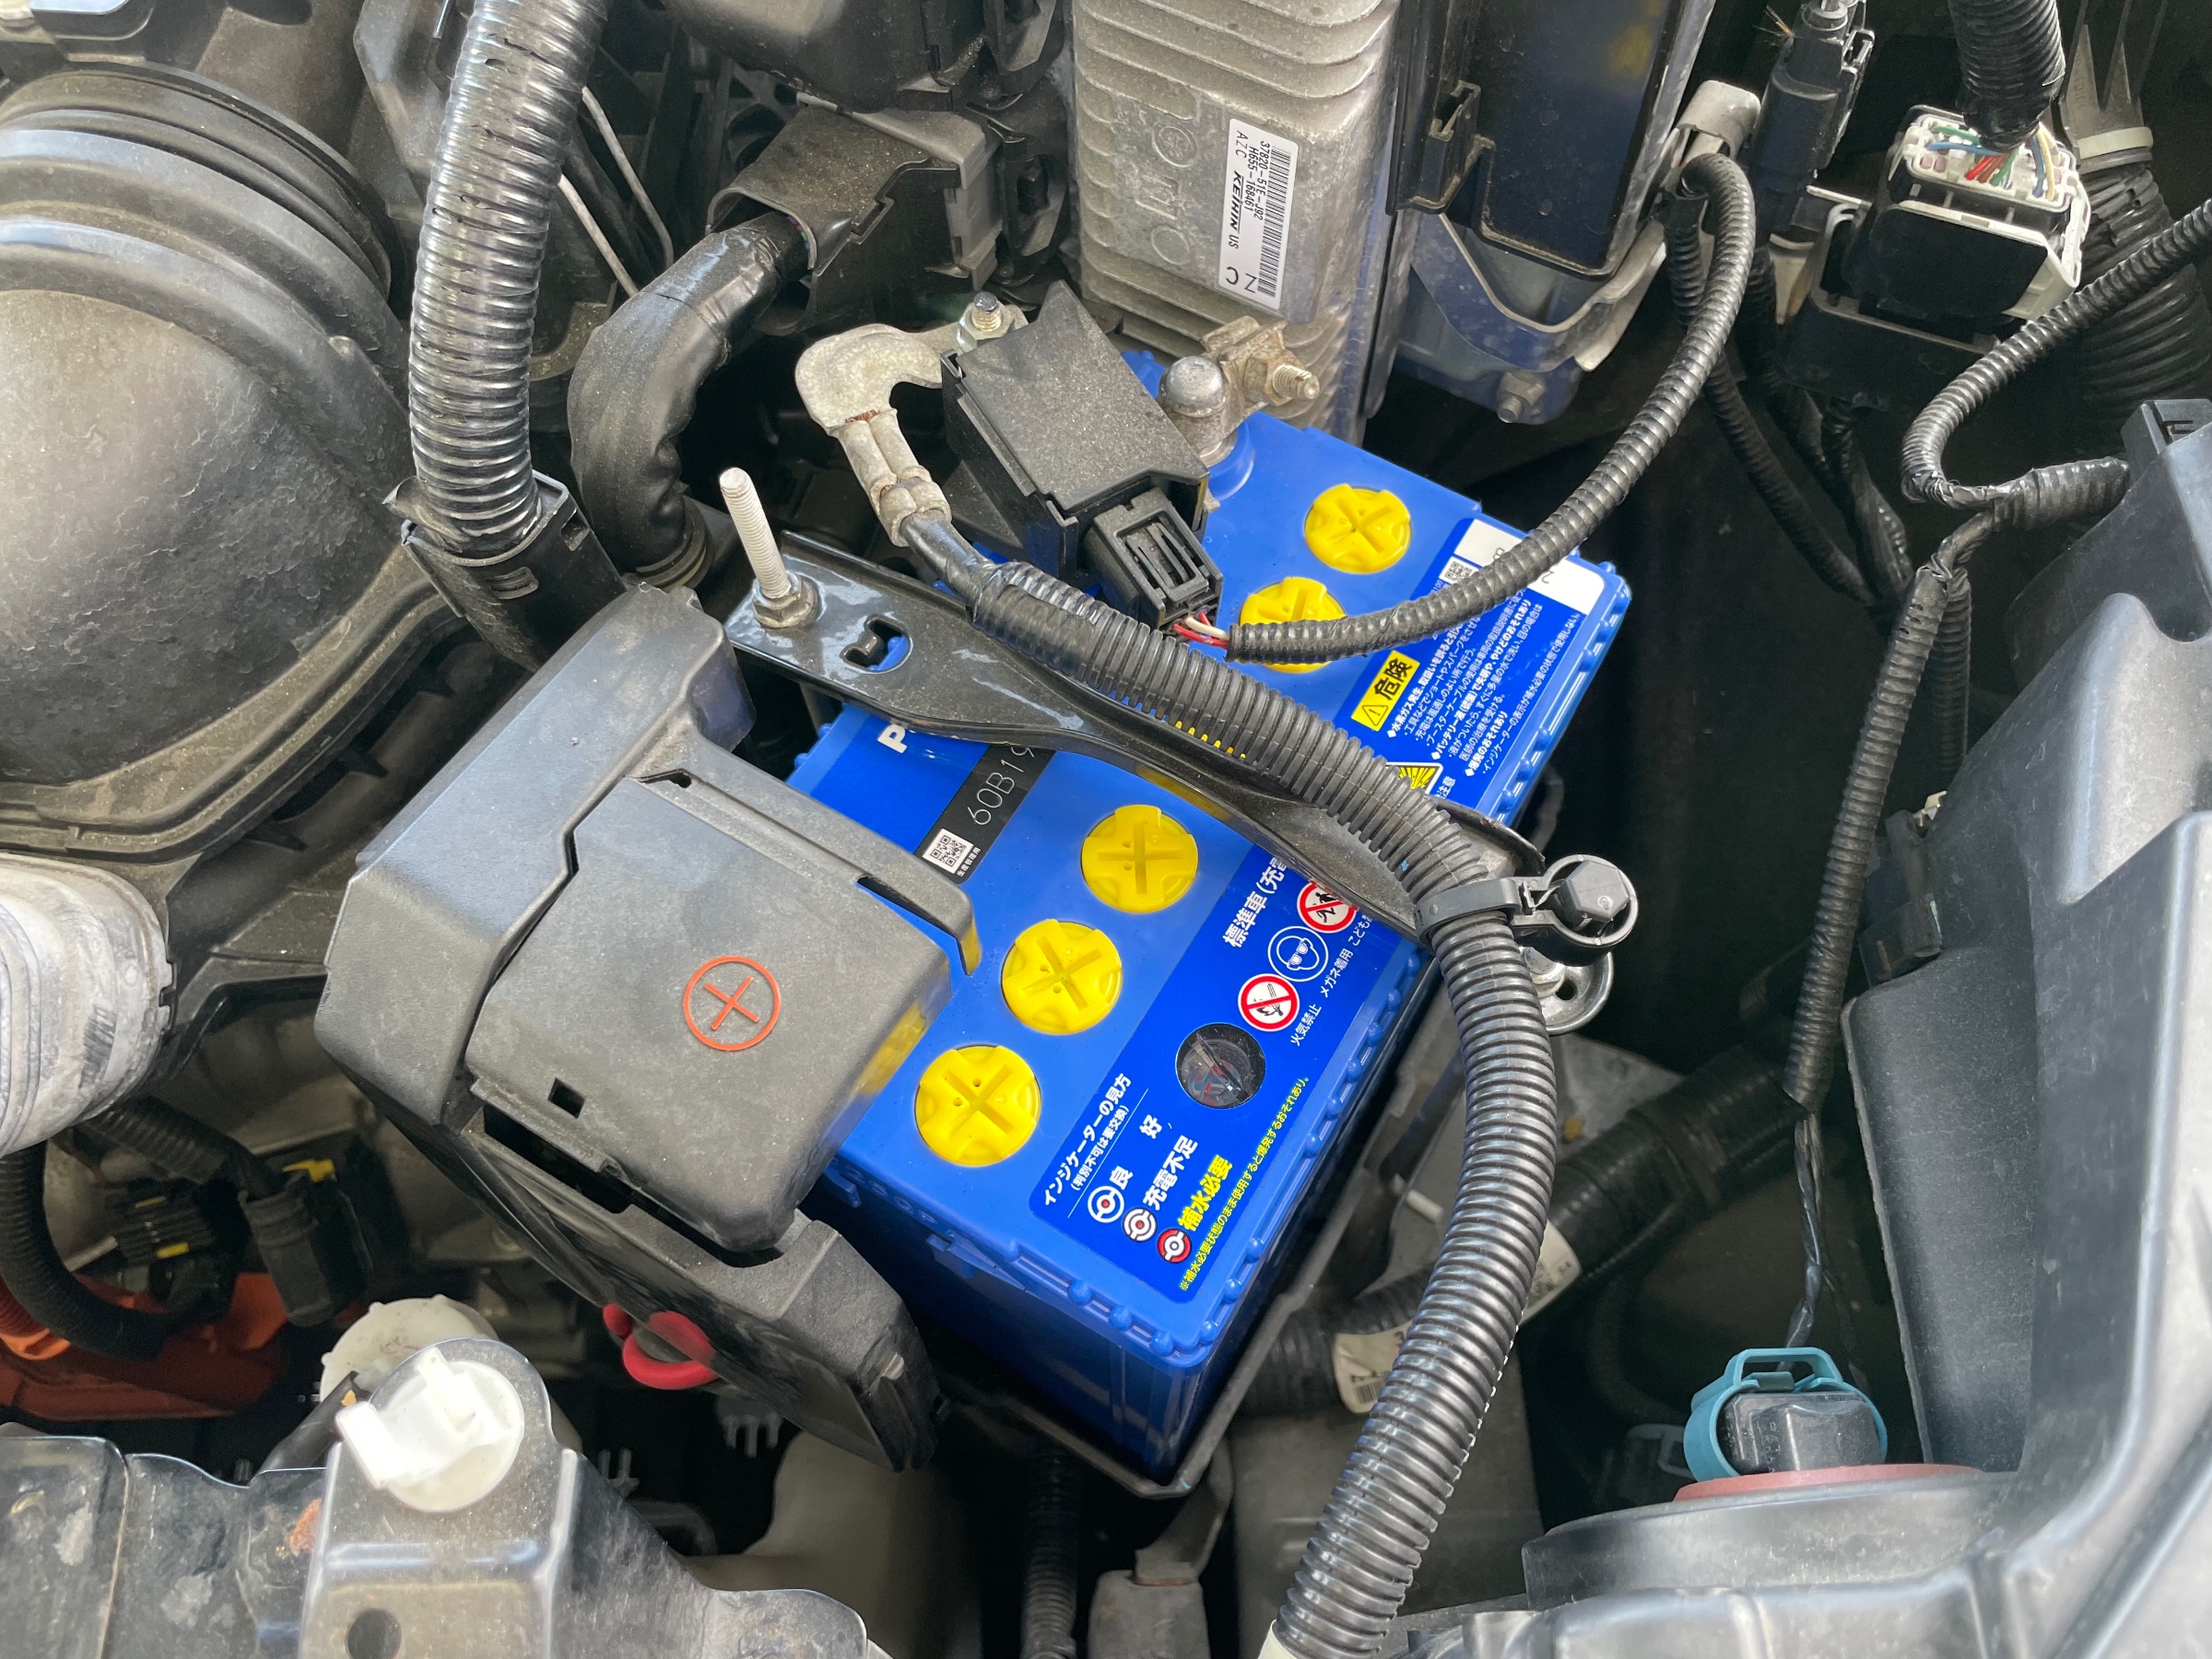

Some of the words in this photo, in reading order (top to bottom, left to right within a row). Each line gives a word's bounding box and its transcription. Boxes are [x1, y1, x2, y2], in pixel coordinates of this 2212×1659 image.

[1229, 171, 1244, 233] KEIHIN
[1244, 146, 1259, 213] H655-168461
[1253, 141, 1270, 220] 37820-51E-J92
[1229, 234, 1240, 249] US
[1374, 659, 1410, 699] 危険
[1320, 947, 1353, 997] メガネ着用
[1290, 1003, 1322, 1046] 火気禁止
[1044, 1073, 1131, 1205] インジケーターの見方
[1109, 1165, 1133, 1190] 良
[1138, 1114, 1162, 1138] 好
[1142, 1135, 1197, 1210] 充電不足
[1177, 1154, 1232, 1231] 補水必要
